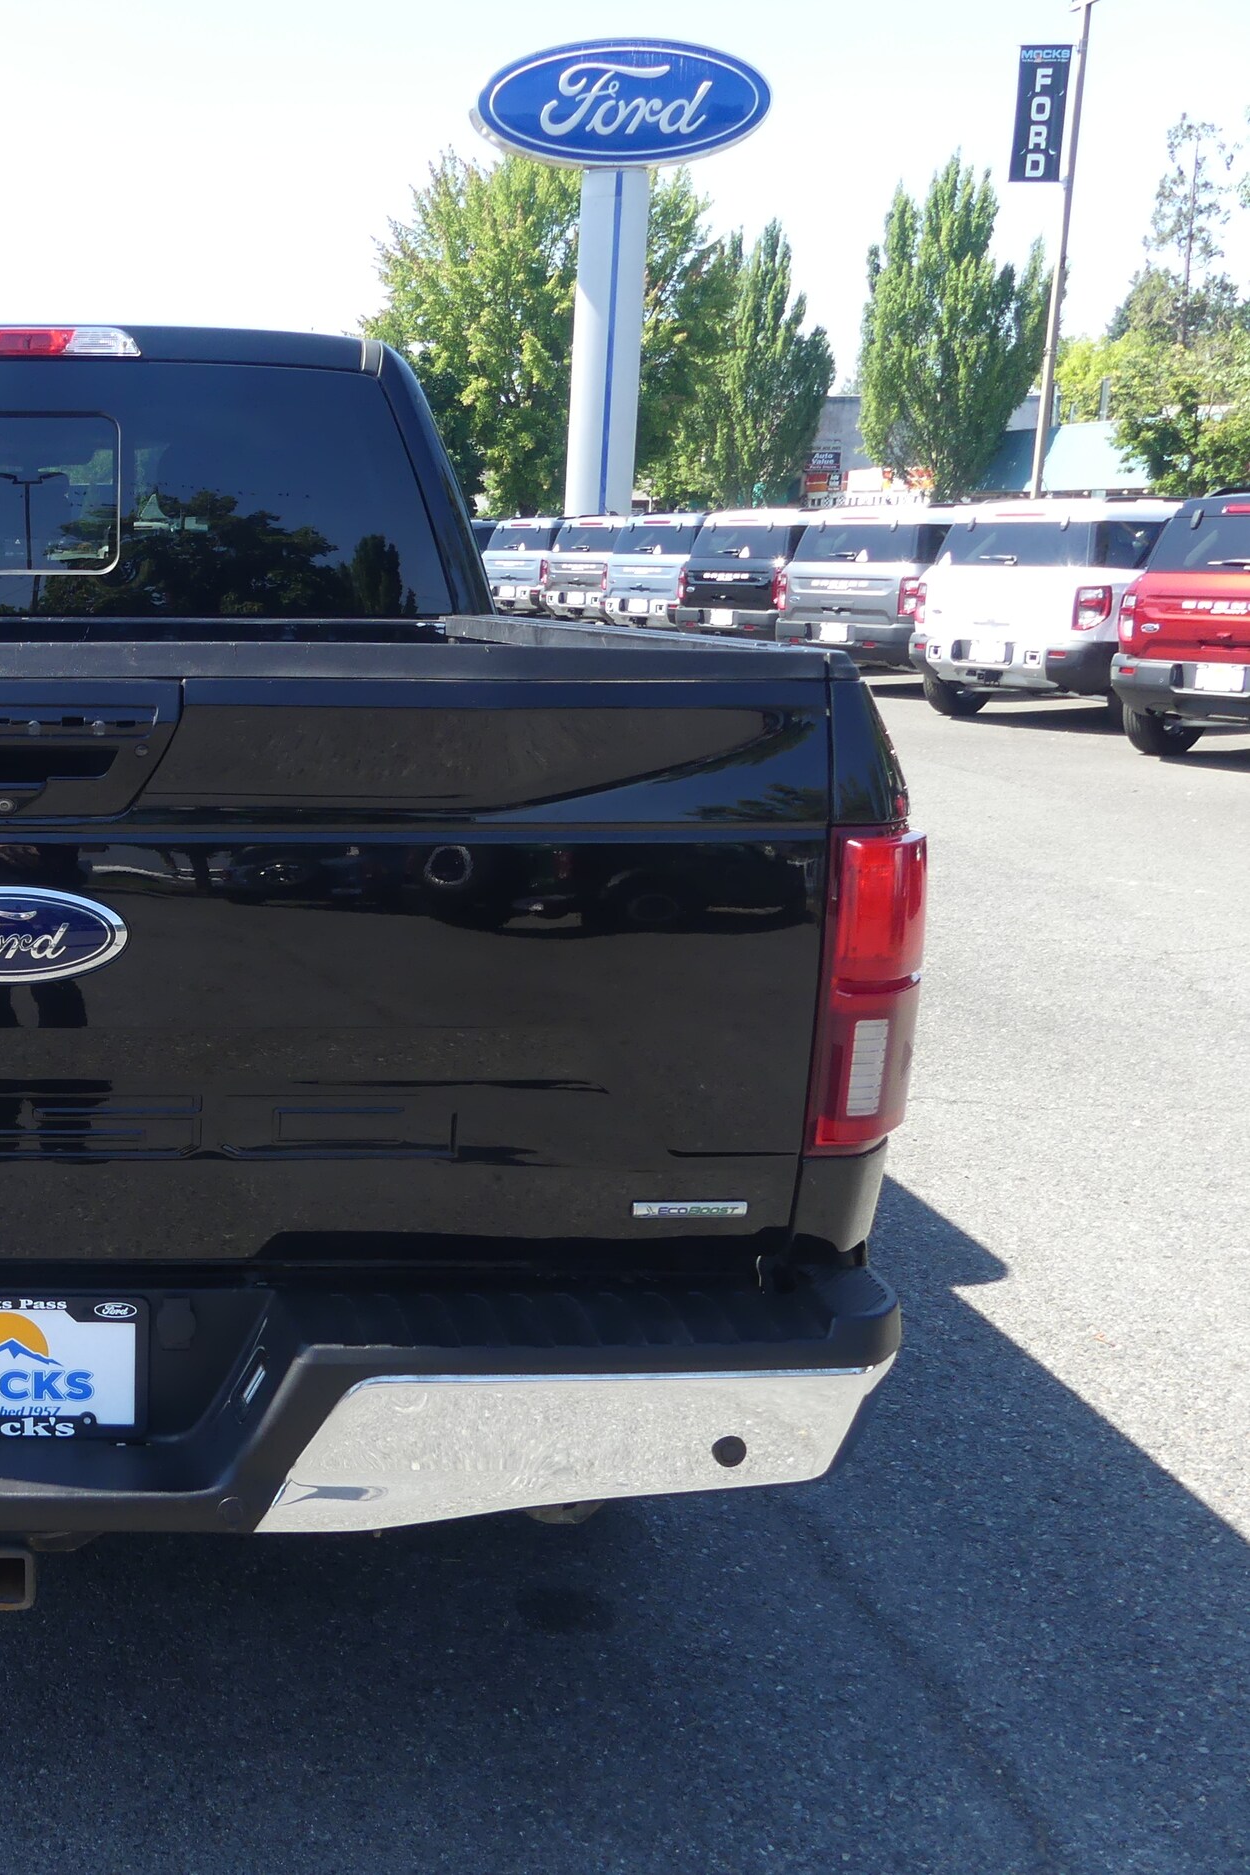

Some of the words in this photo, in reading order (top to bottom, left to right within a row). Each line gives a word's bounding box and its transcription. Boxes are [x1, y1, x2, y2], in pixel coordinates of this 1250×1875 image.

[1021, 49, 1071, 59] MOCKS
[539, 62, 713, 137] Ford
[1024, 67, 1054, 178] FORD
[18, 1299, 68, 1310] Pass
[101, 1304, 129, 1316] Ford
[28, 1405, 61, 1417] 1957
